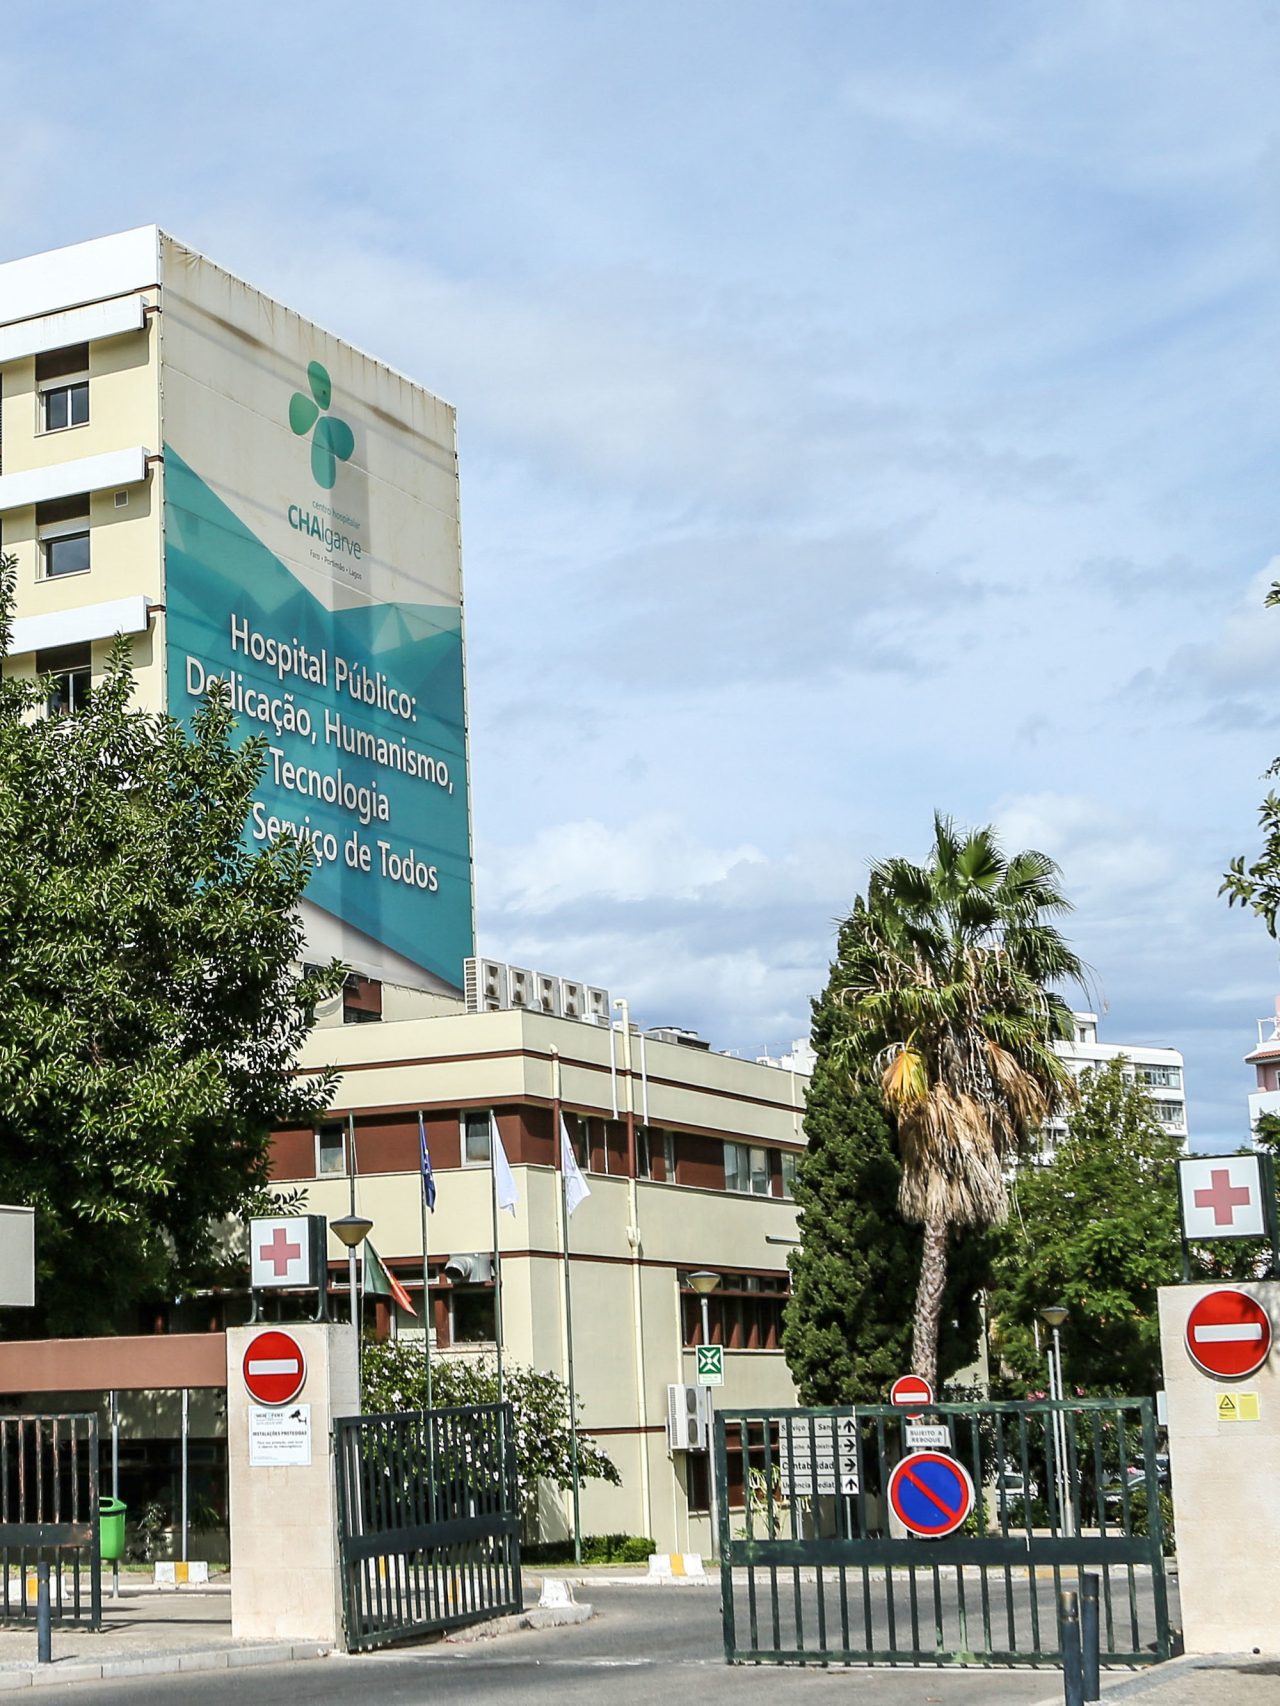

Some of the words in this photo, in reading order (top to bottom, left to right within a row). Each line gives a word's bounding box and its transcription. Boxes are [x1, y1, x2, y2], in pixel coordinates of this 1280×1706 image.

[288, 504, 362, 560] CHAlgarve
[231, 613, 328, 687] Hospital
[335, 656, 417, 722] Público:
[269, 747, 390, 825] Tecnologia
[325, 709, 454, 795] Humanismo,
[252, 802, 337, 867] Serviço
[344, 831, 371, 872] de
[377, 840, 439, 892] Todos
[781, 1424, 806, 1432] Sviço
[817, 1423, 842, 1431] Sane
[782, 1461, 835, 1470] Cntabidad
